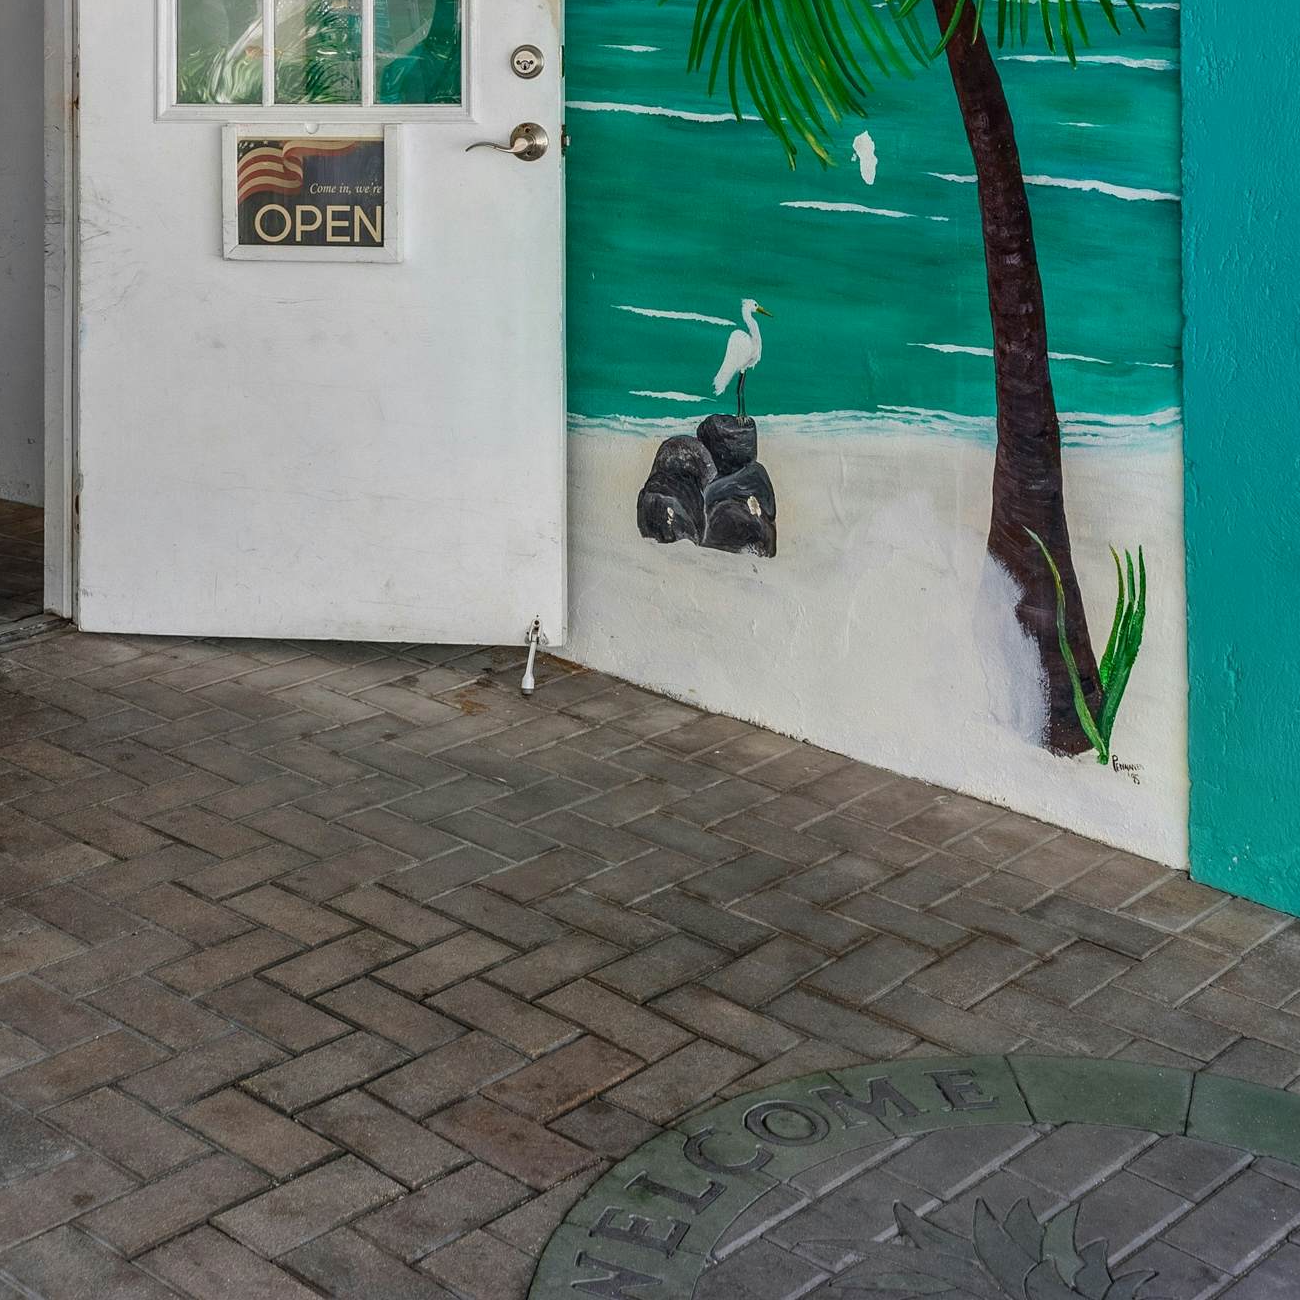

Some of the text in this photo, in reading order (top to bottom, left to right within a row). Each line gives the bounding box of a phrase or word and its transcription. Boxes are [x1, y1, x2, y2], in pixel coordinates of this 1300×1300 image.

[309, 182, 382, 195] Come in, we're
[254, 203, 382, 243] OPEN
